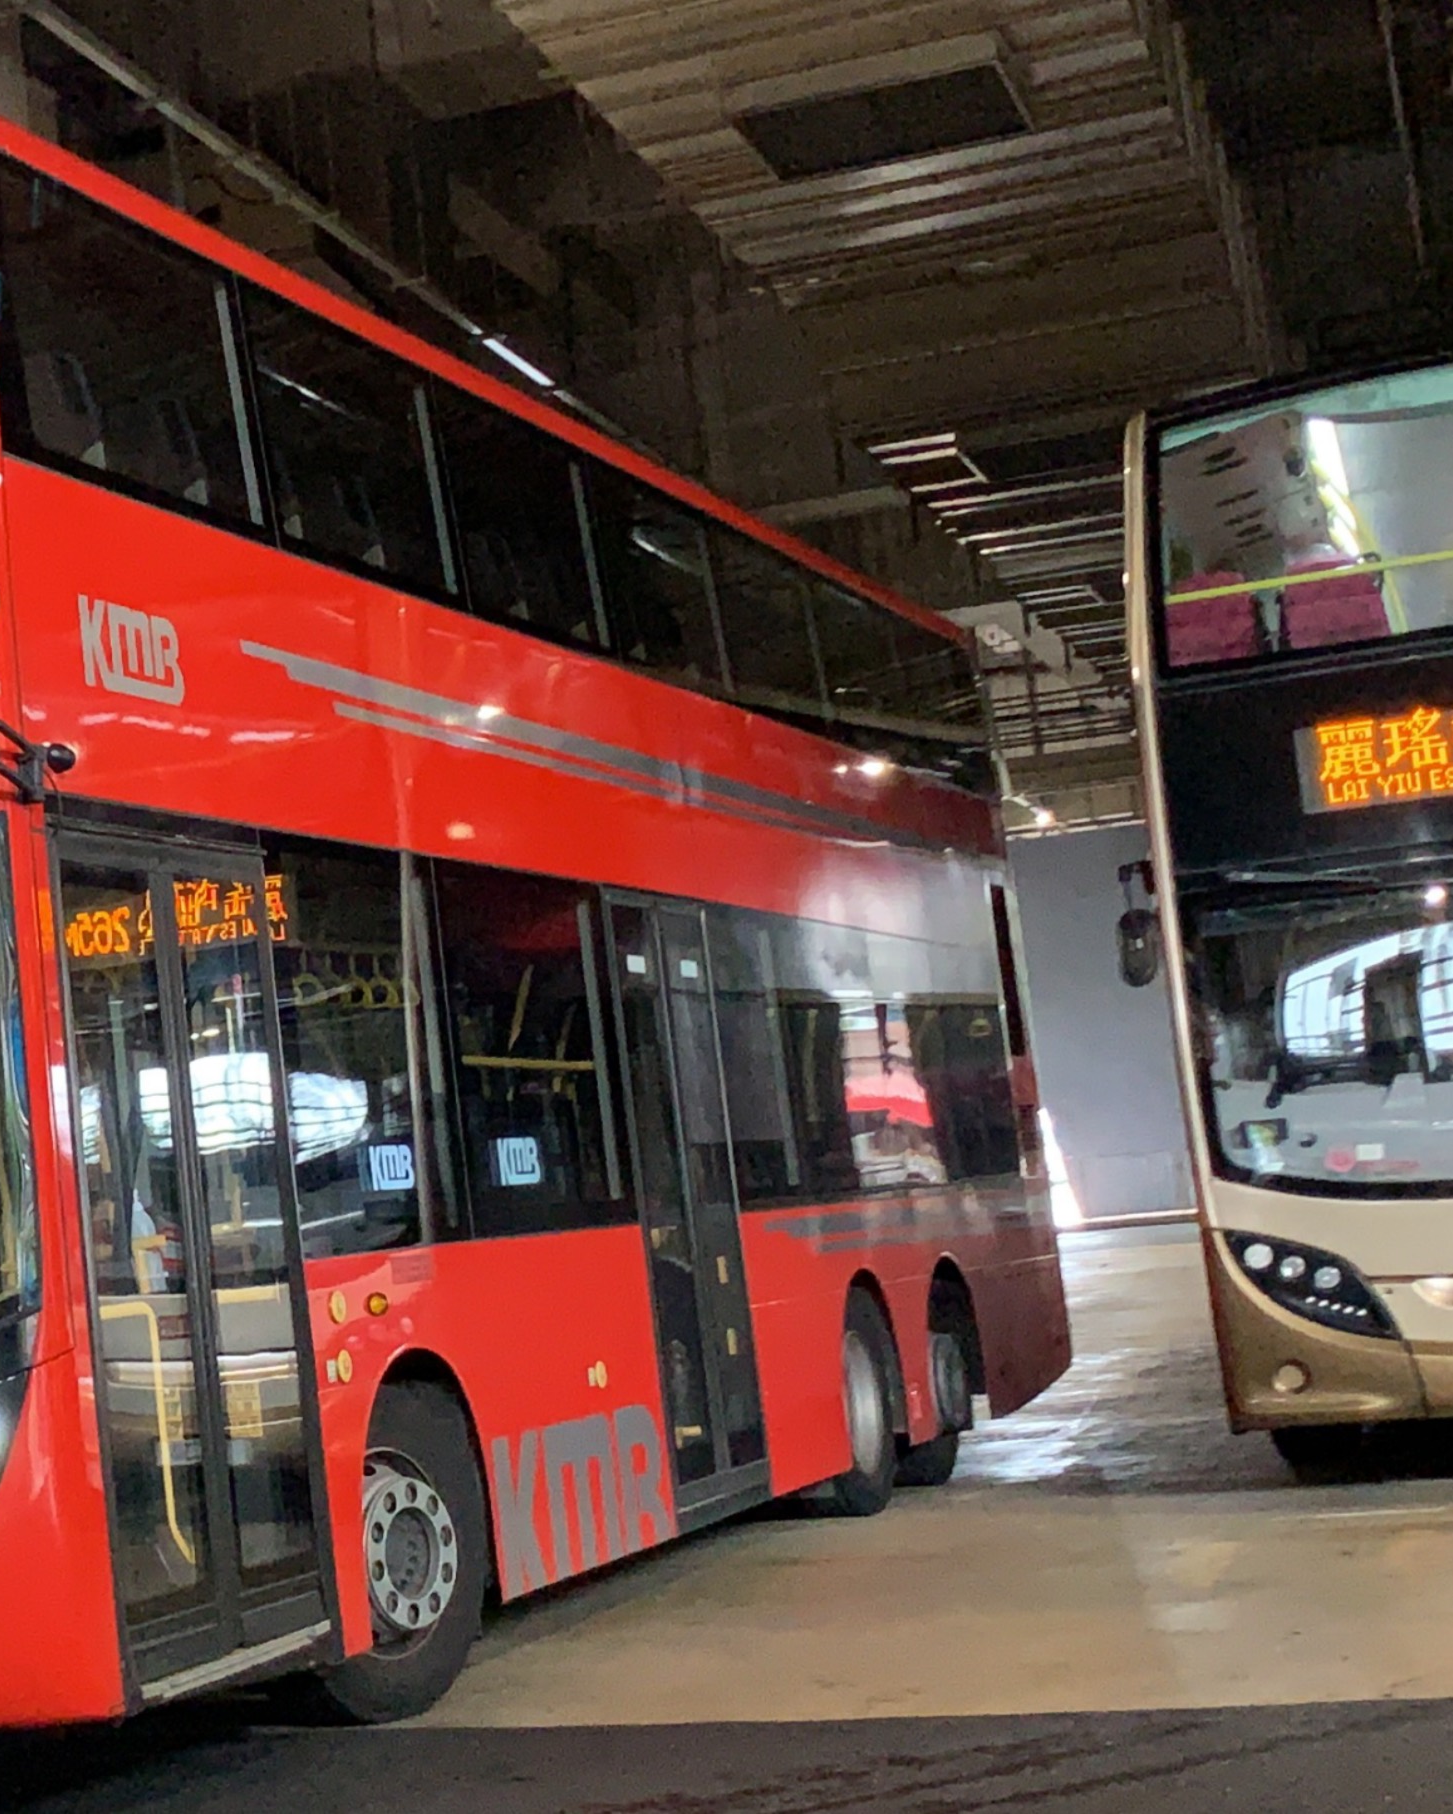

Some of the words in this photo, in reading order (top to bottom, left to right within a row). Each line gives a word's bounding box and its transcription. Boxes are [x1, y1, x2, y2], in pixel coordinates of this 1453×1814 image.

[78, 593, 185, 707] KMB
[1328, 778, 1370, 804] LAI
[1376, 771, 1422, 797] YIU
[369, 1144, 415, 1191] KMB
[497, 1137, 541, 1187] KMB
[492, 1404, 671, 1601] KMB
